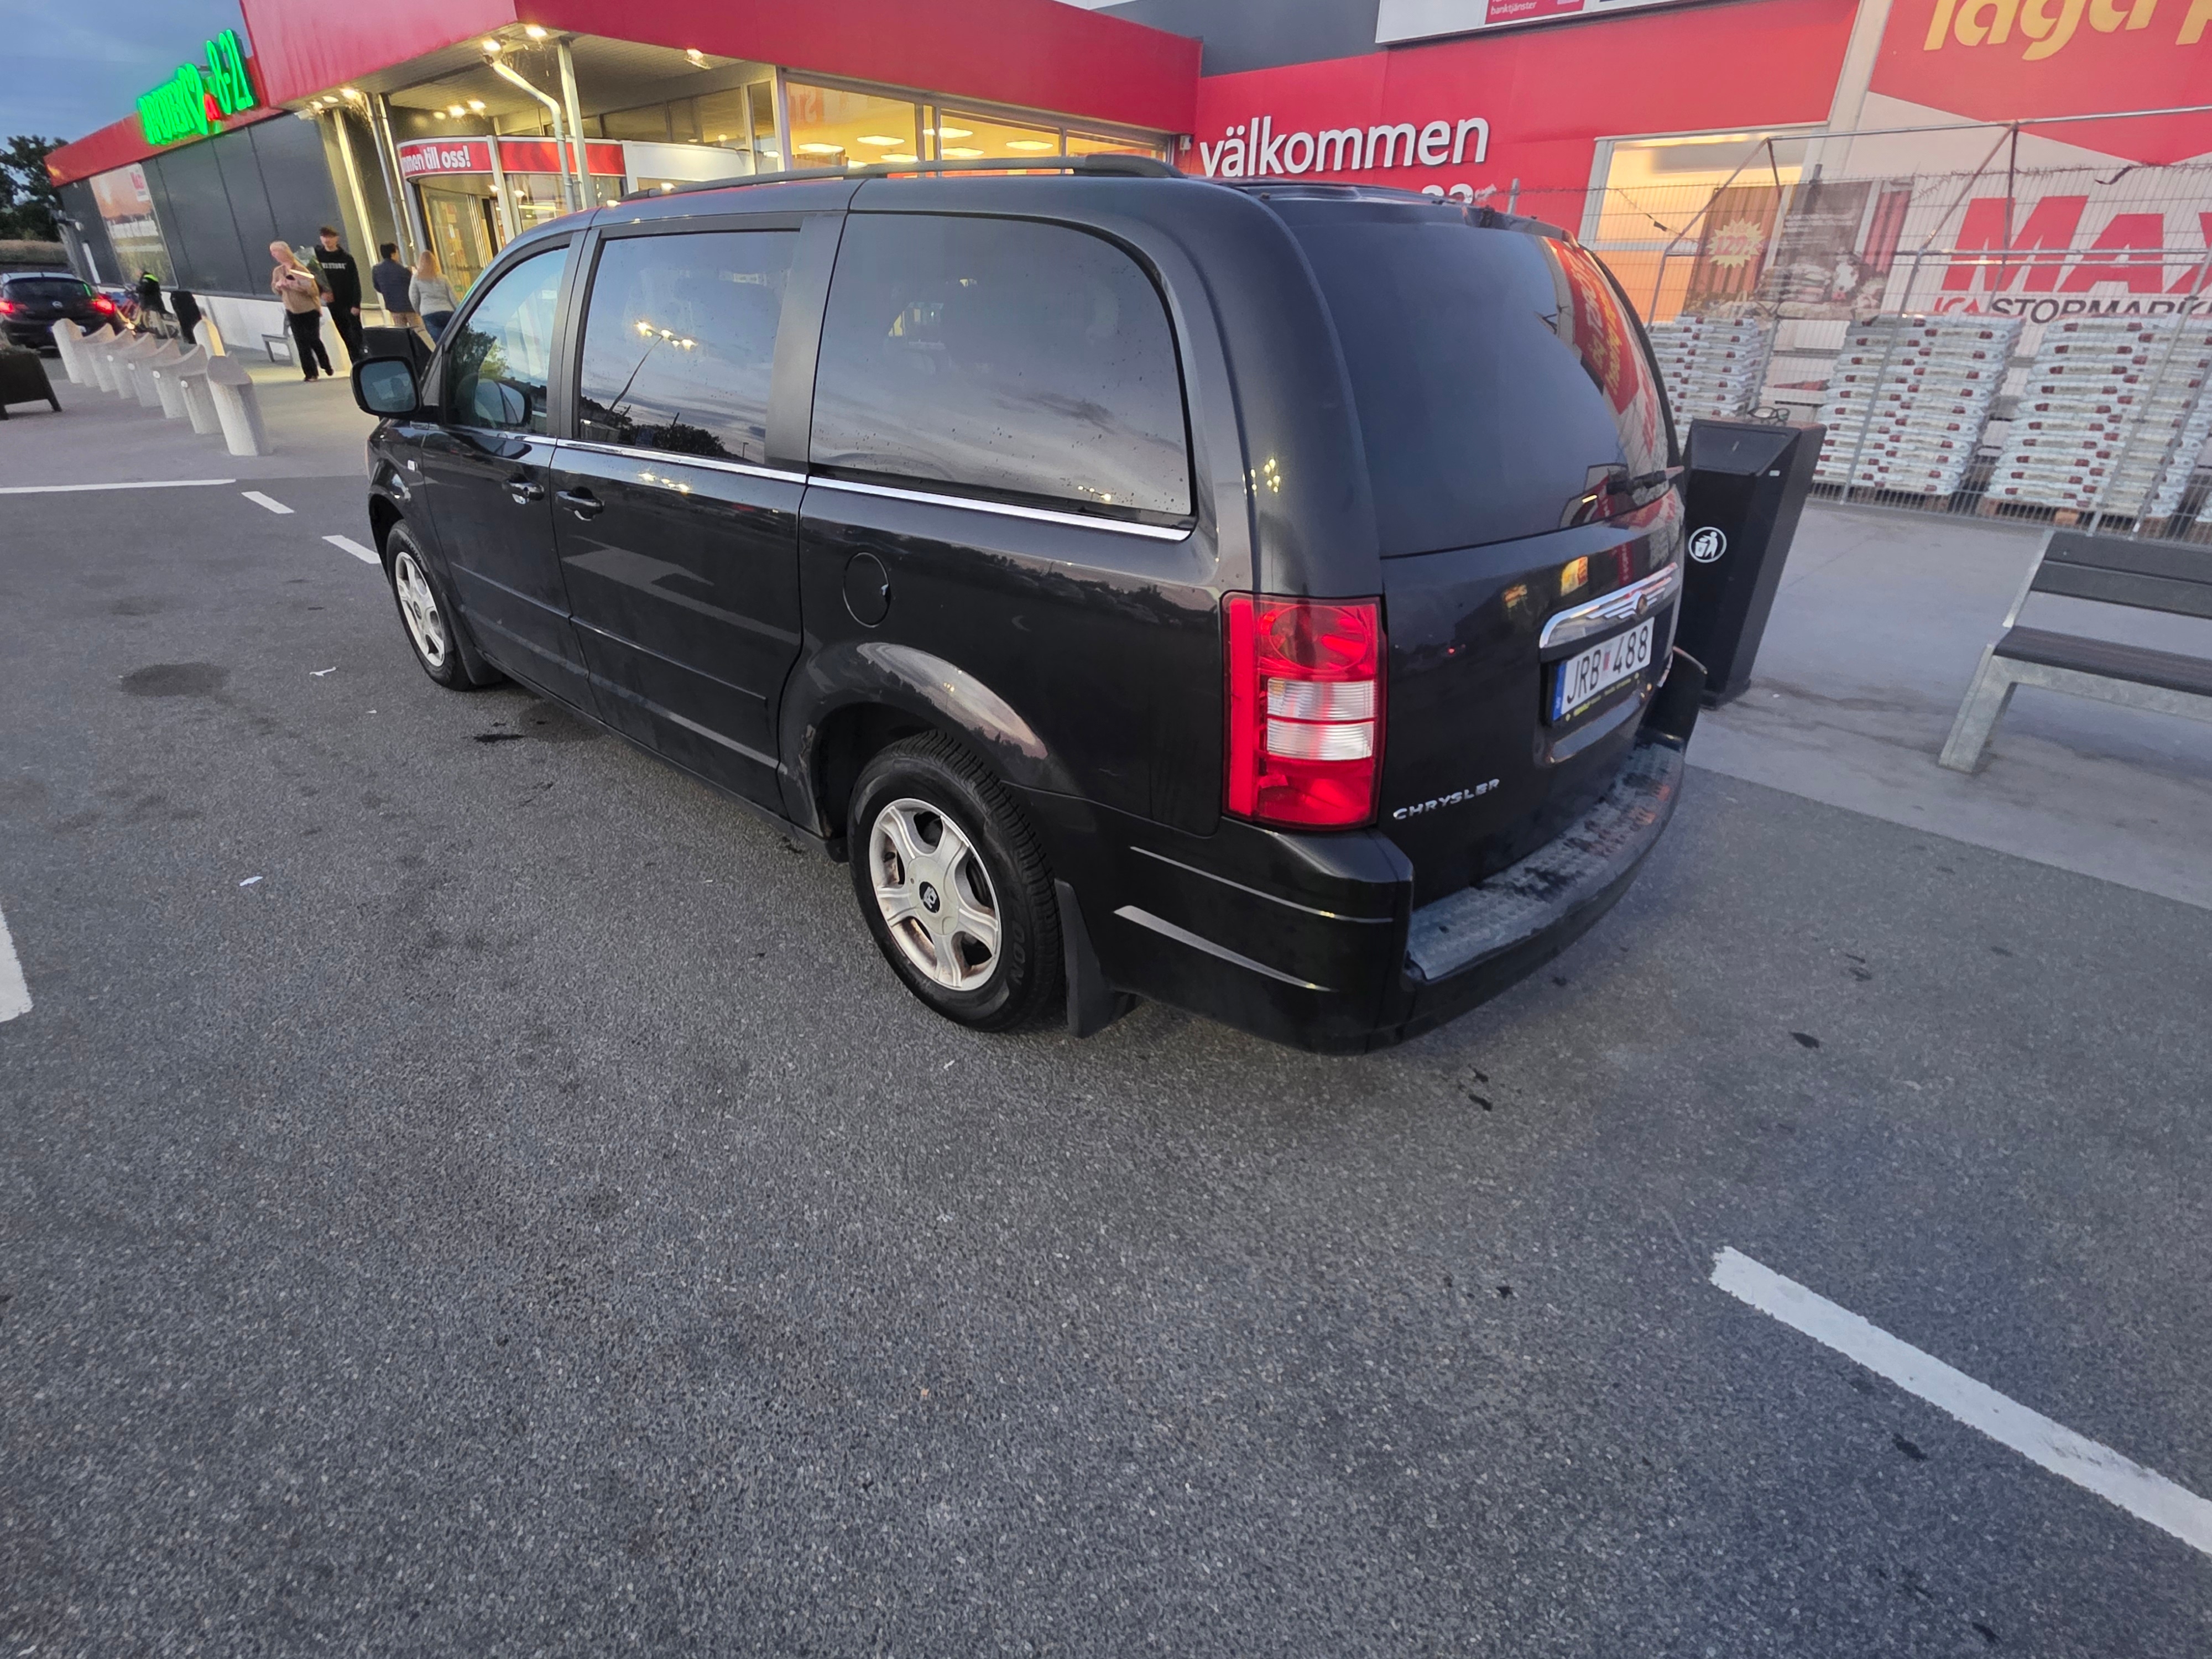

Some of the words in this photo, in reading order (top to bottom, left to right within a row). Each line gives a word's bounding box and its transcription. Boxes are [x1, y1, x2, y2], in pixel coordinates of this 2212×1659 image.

[423, 147, 441, 169] till
[442, 145, 471, 169] oss!
[1199, 116, 1489, 178] välkommen
[1567, 649, 1601, 704] JRB
[1613, 625, 1648, 674] 488
[1393, 778, 1500, 820] CHRYSLER
